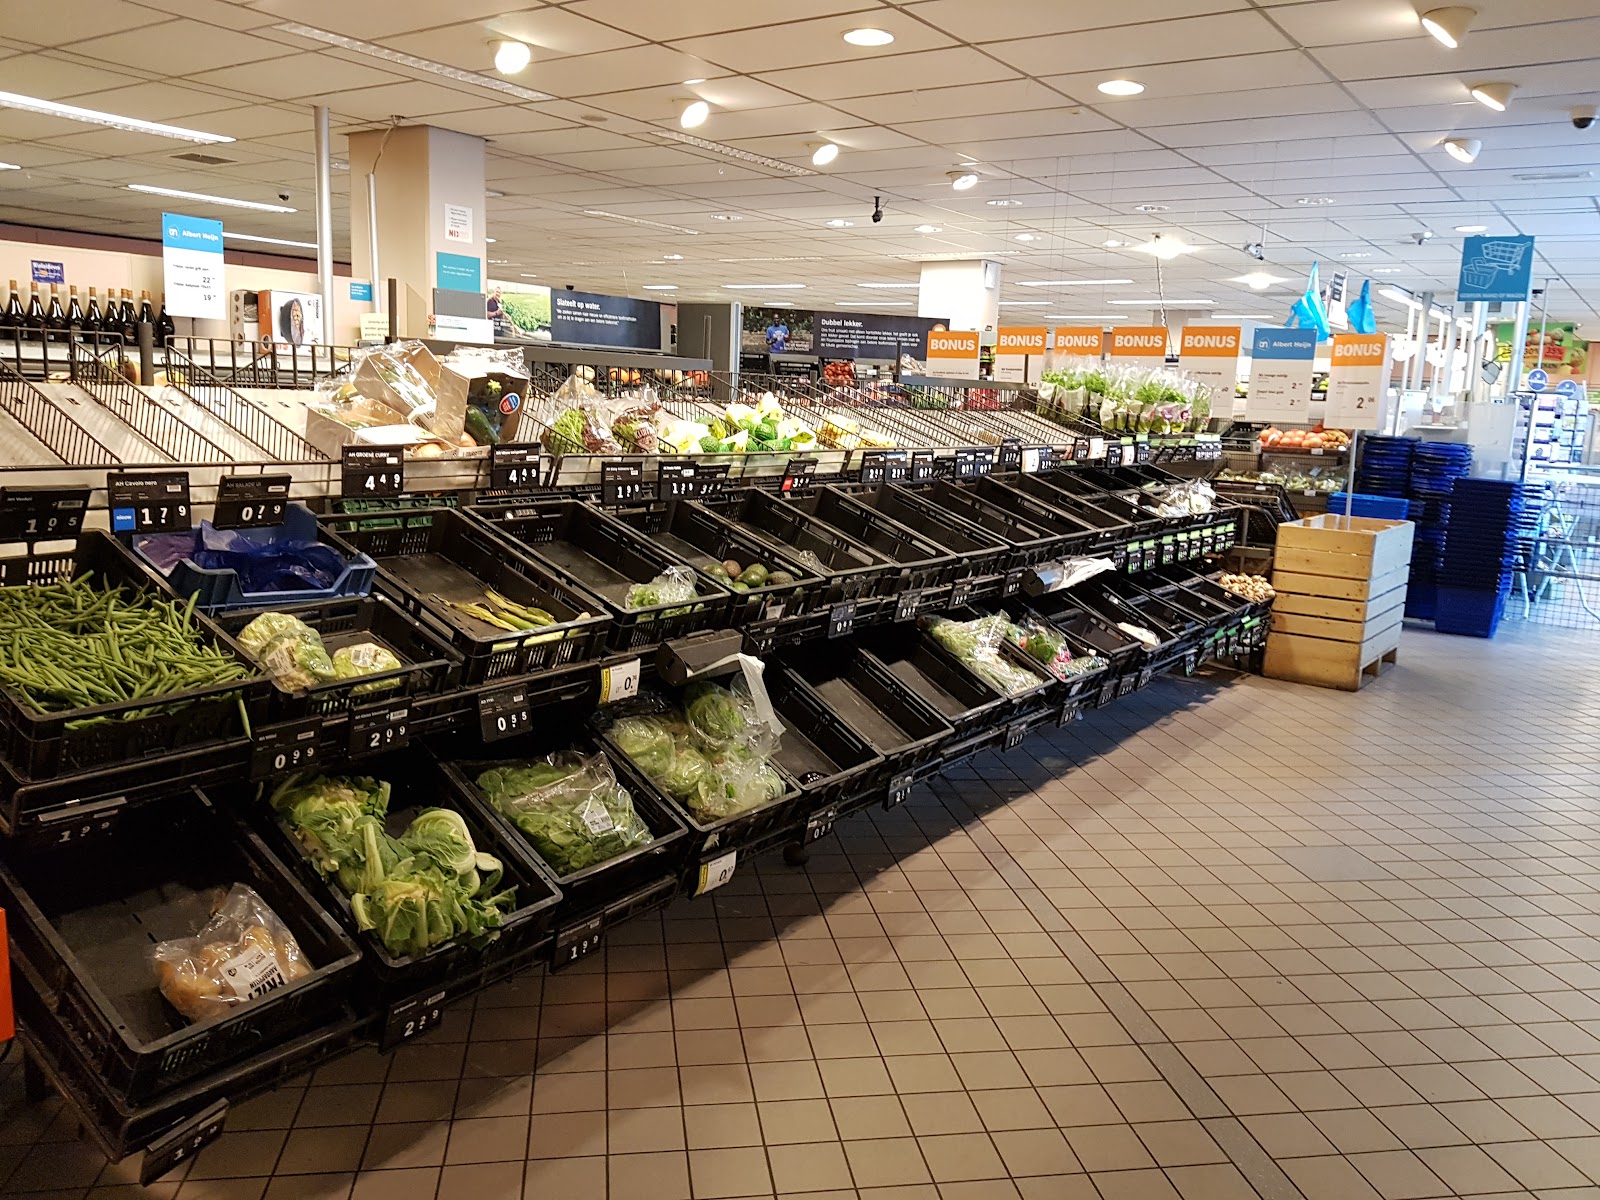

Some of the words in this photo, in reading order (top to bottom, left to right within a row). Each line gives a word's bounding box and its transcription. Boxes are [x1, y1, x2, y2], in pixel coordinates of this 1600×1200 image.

[182, 230, 201, 238] Albert
[203, 233, 218, 241] Heijn
[931, 339, 975, 351] BONUS
[1000, 335, 1043, 346] BONUS
[1057, 335, 1099, 347] BONUS
[1115, 335, 1163, 348] BONUS
[1184, 335, 1236, 348] BONUS
[1335, 343, 1382, 356] BONUS
